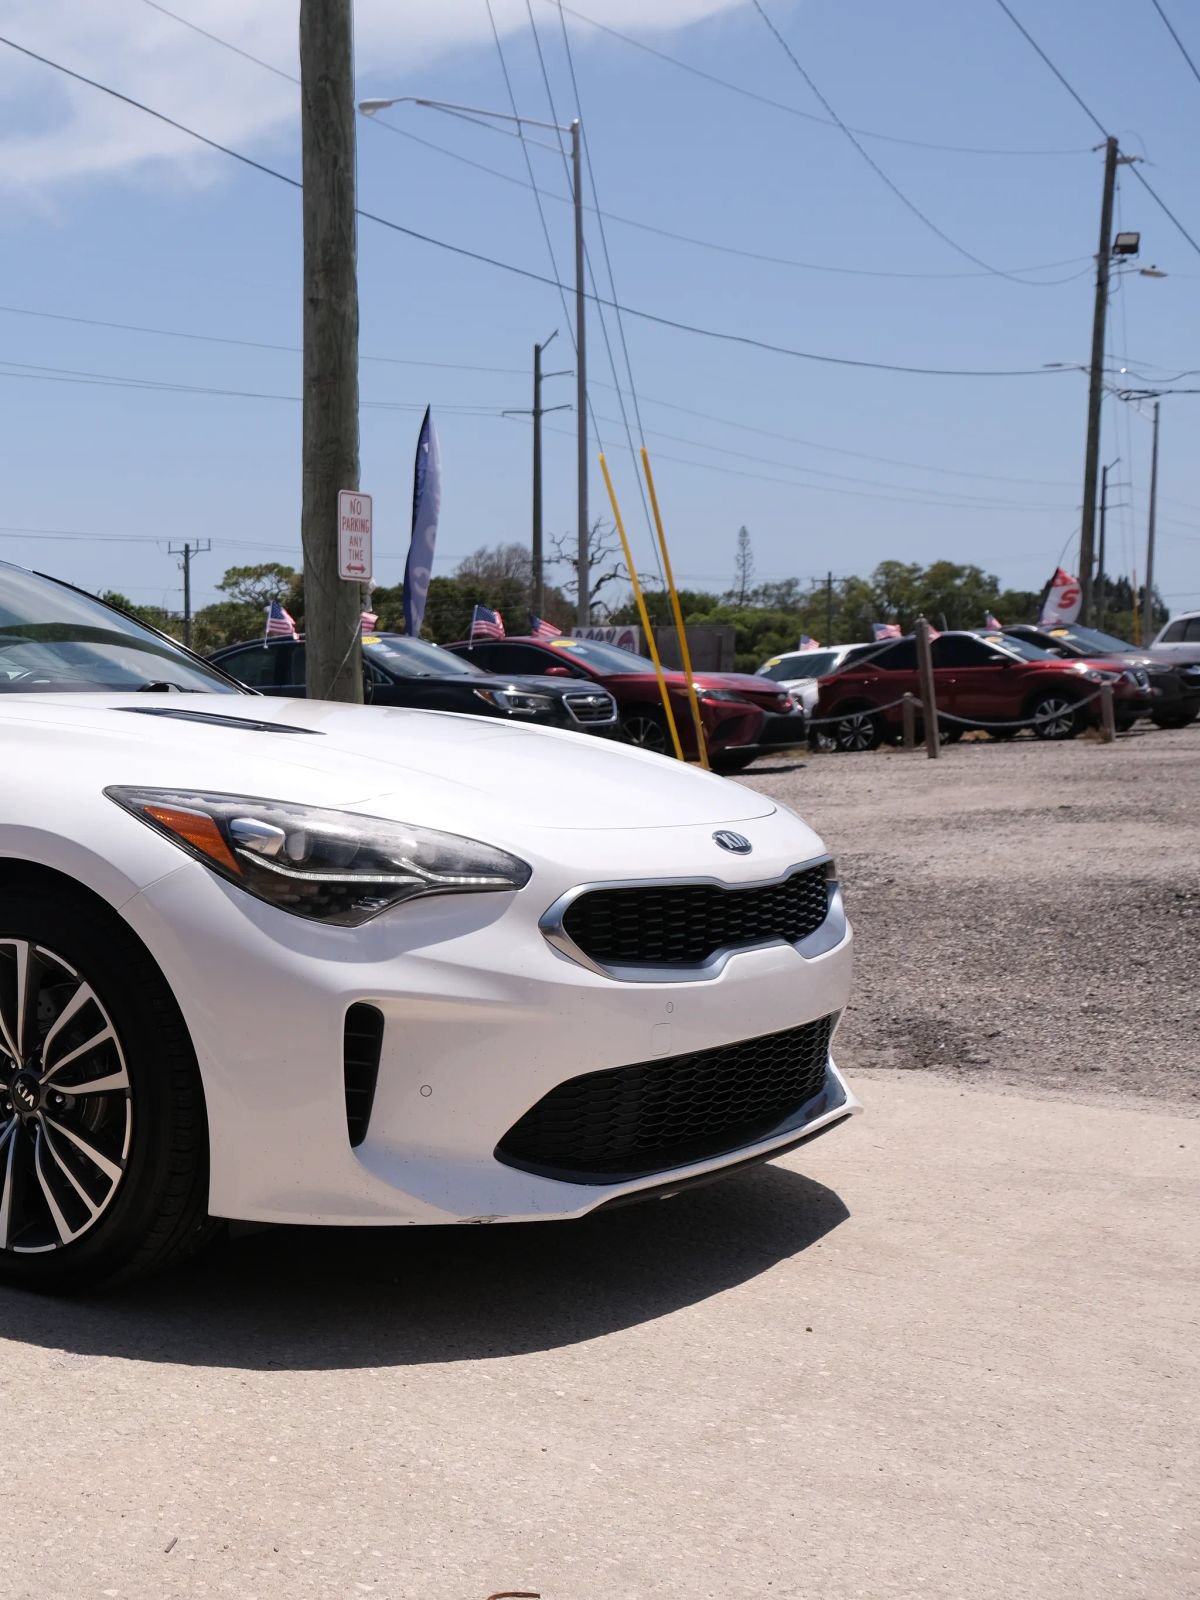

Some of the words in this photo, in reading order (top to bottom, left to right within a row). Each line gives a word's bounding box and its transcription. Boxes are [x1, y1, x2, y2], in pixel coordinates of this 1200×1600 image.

[350, 498, 362, 516] NO
[342, 516, 369, 533] PARKING
[349, 535, 363, 549] ANY
[348, 548, 364, 561] TIME
[714, 831, 751, 851] KIA
[14, 1078, 35, 1108] KIA
